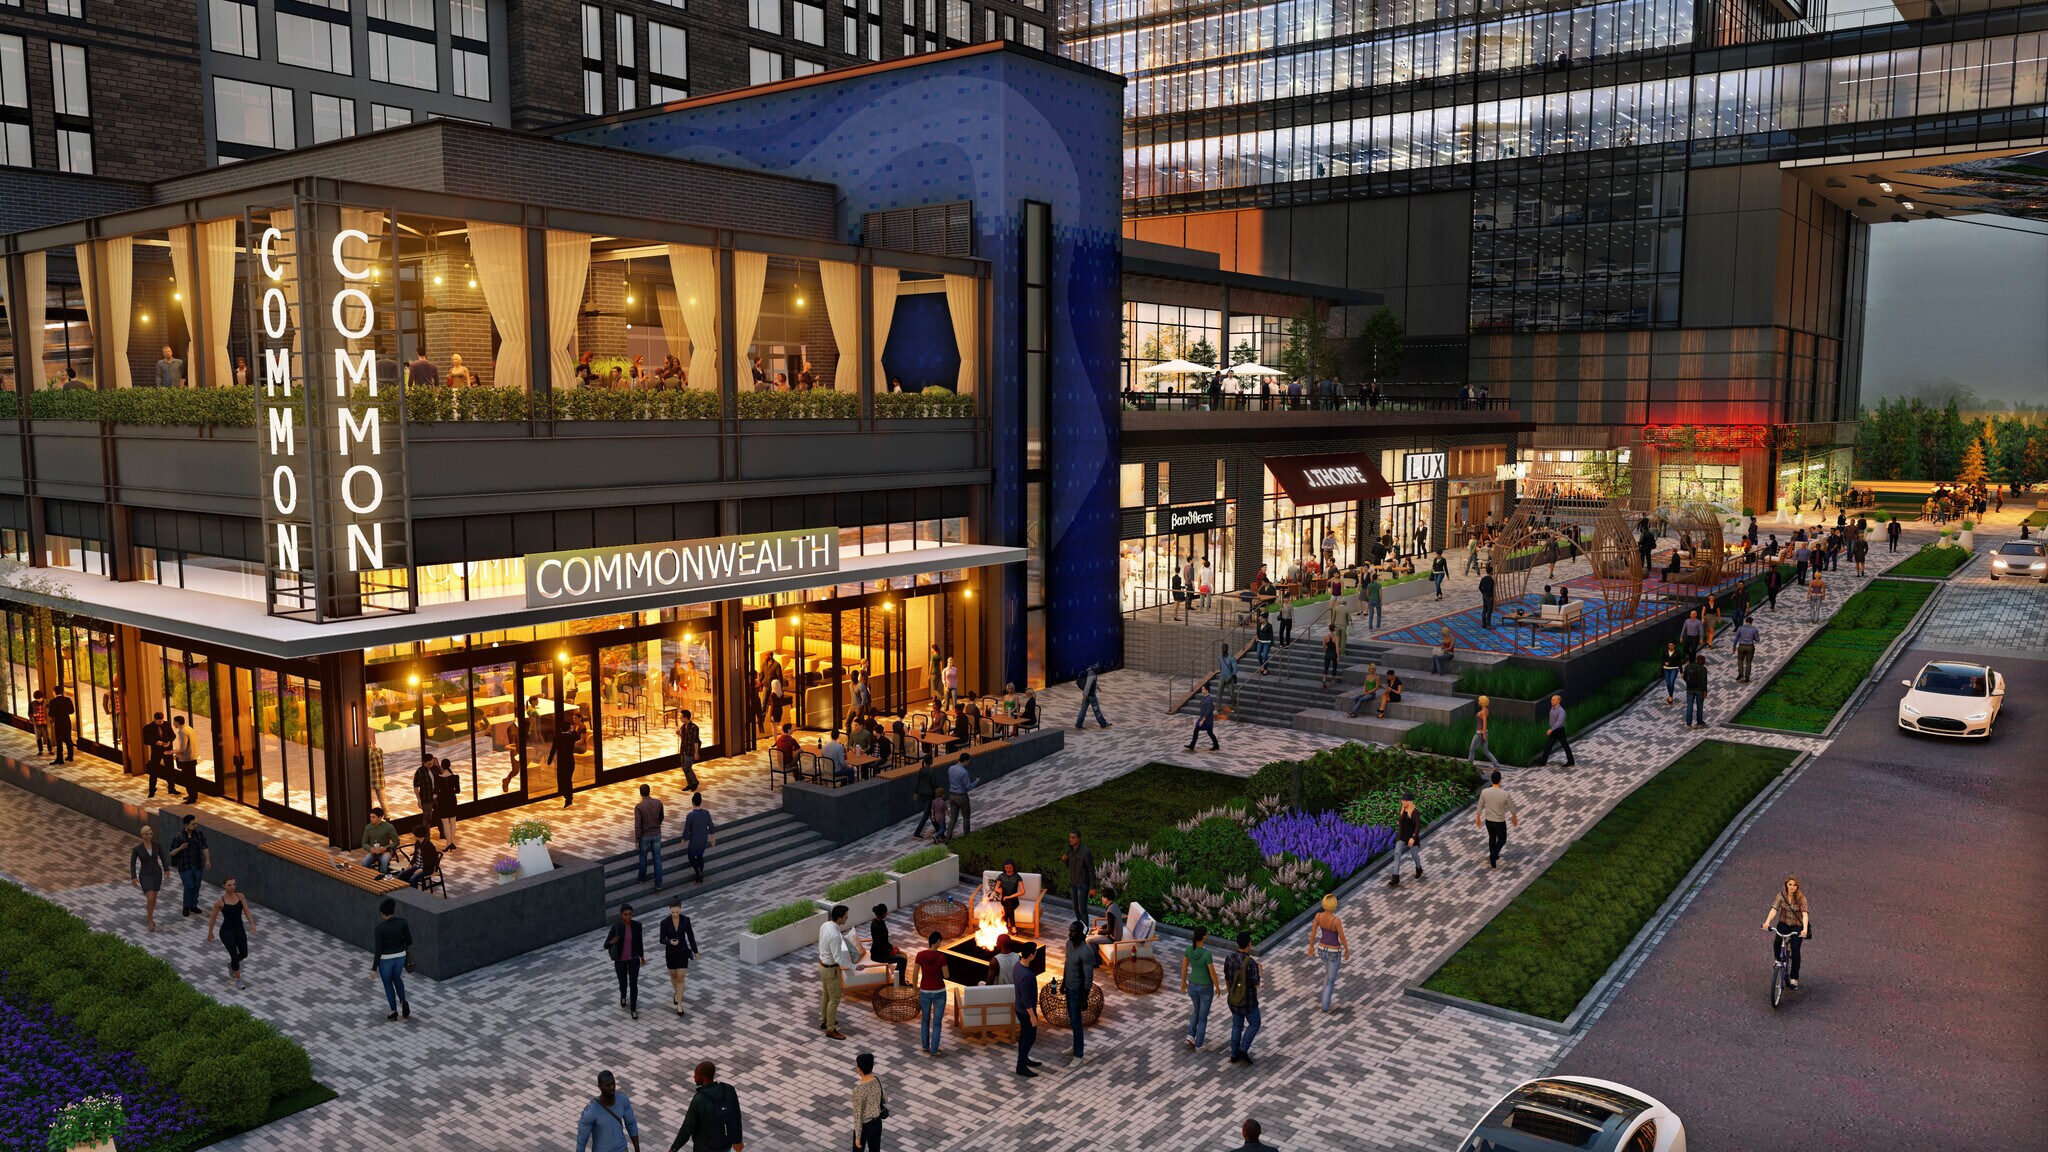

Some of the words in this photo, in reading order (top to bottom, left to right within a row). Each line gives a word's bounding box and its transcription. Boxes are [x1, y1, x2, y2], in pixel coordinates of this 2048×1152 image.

[261, 227, 299, 571] COMMON
[332, 229, 384, 571] COMMON
[1641, 423, 1768, 448] CORNER
[1303, 466, 1368, 488] J.THORPE
[1410, 455, 1443, 480] LUX
[536, 533, 830, 599] COMMONWEALTH
